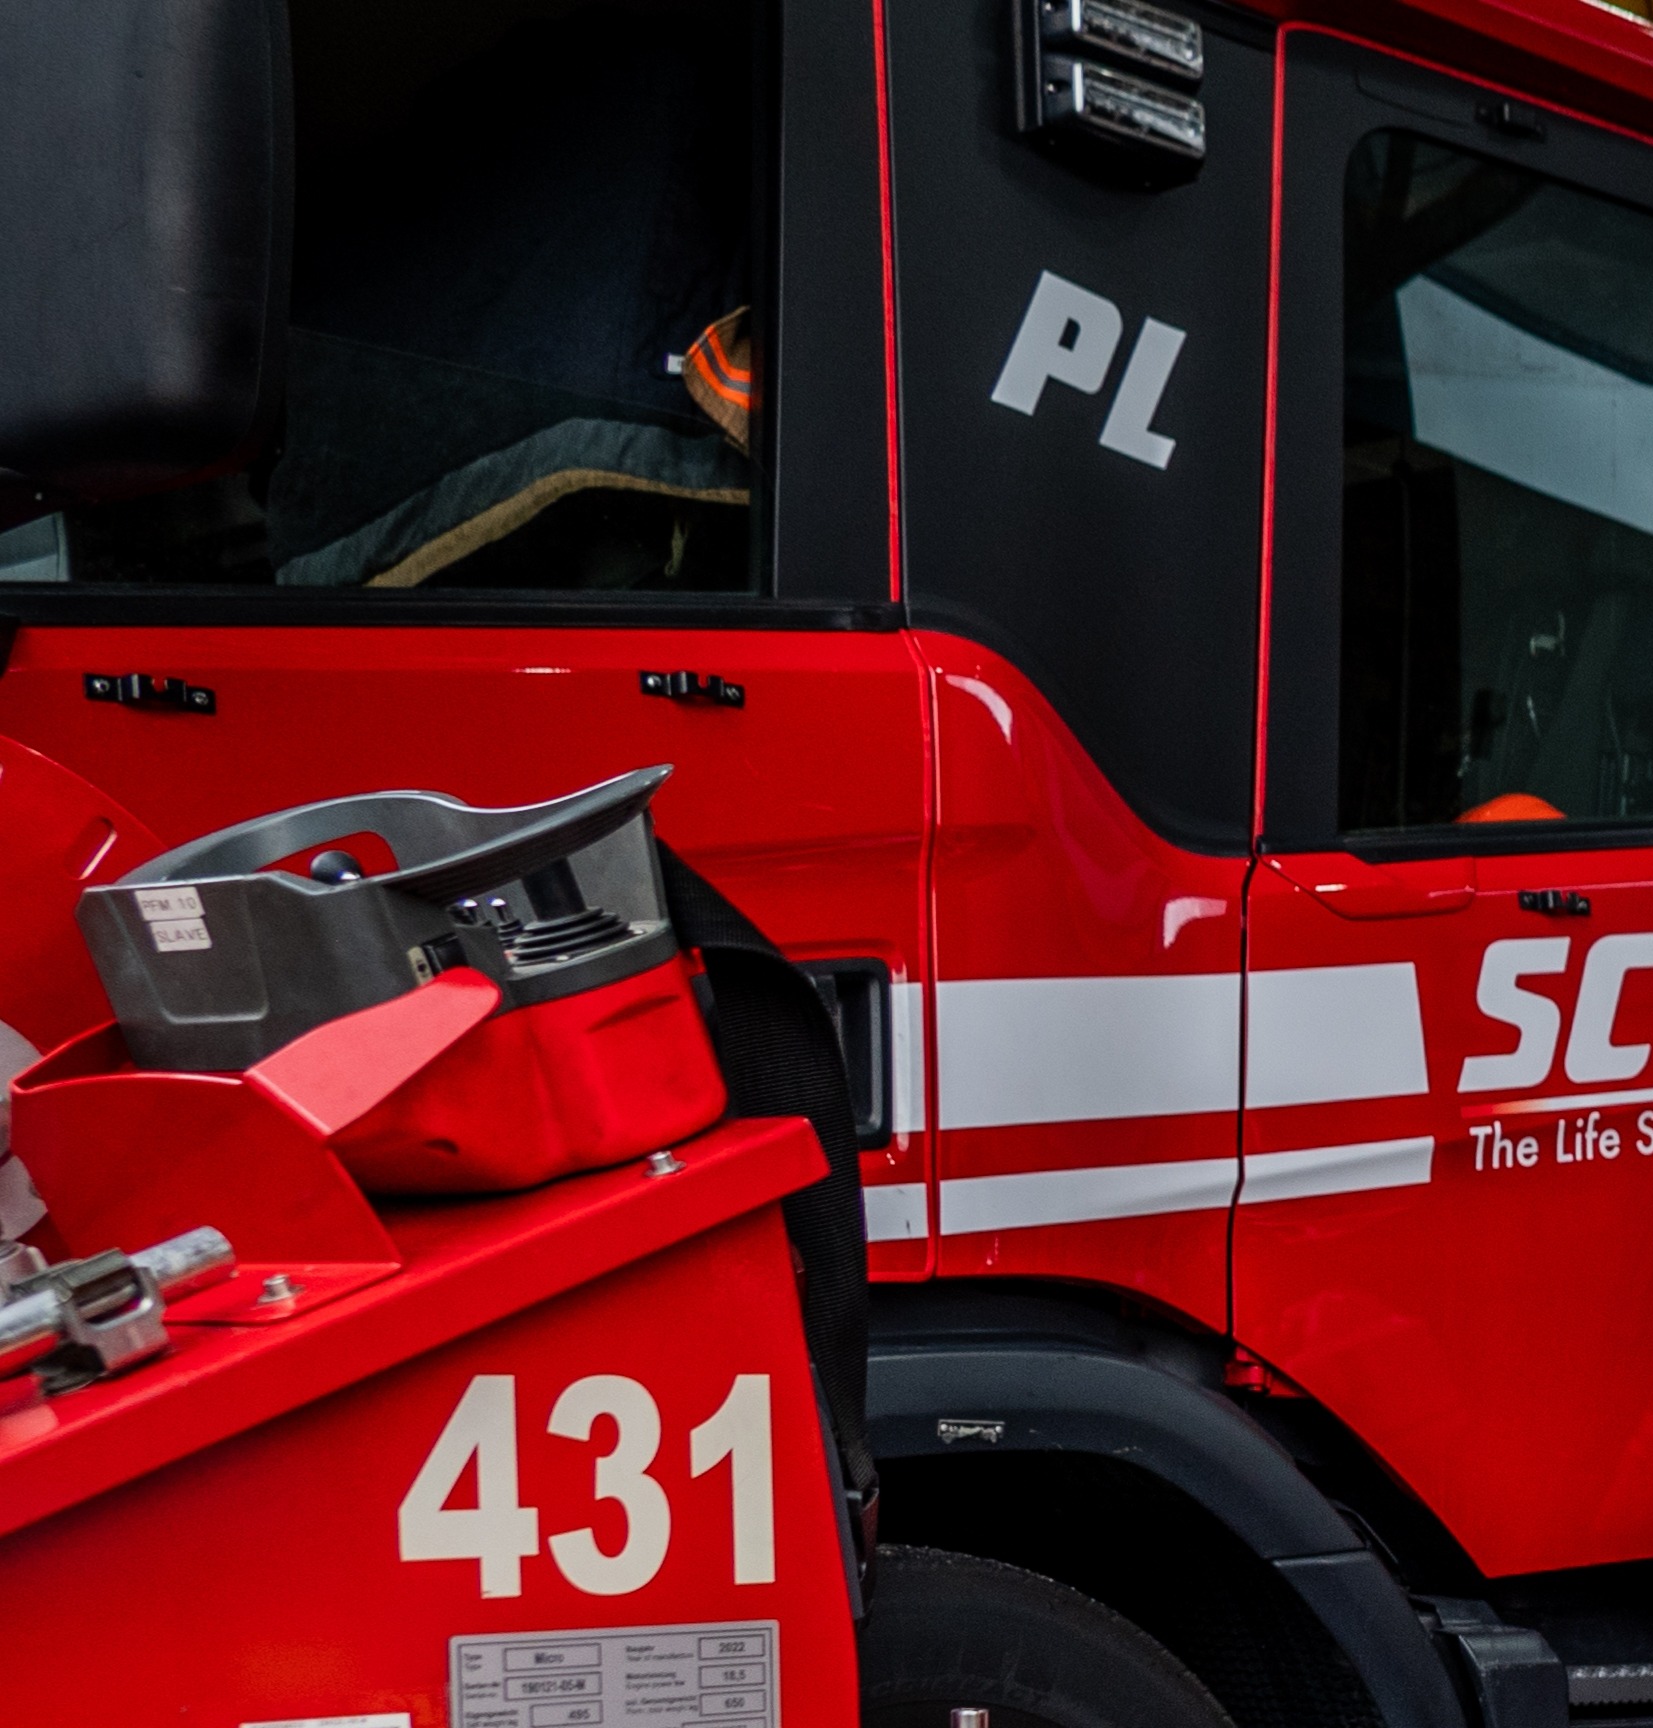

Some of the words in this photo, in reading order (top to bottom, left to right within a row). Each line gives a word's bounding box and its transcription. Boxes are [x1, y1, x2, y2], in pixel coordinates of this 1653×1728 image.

[990, 270, 1187, 470] PL
[157, 928, 207, 943] SLAVE
[1469, 1119, 1540, 1171] The
[1556, 1110, 1622, 1164] Life
[398, 1374, 776, 1599] 431
